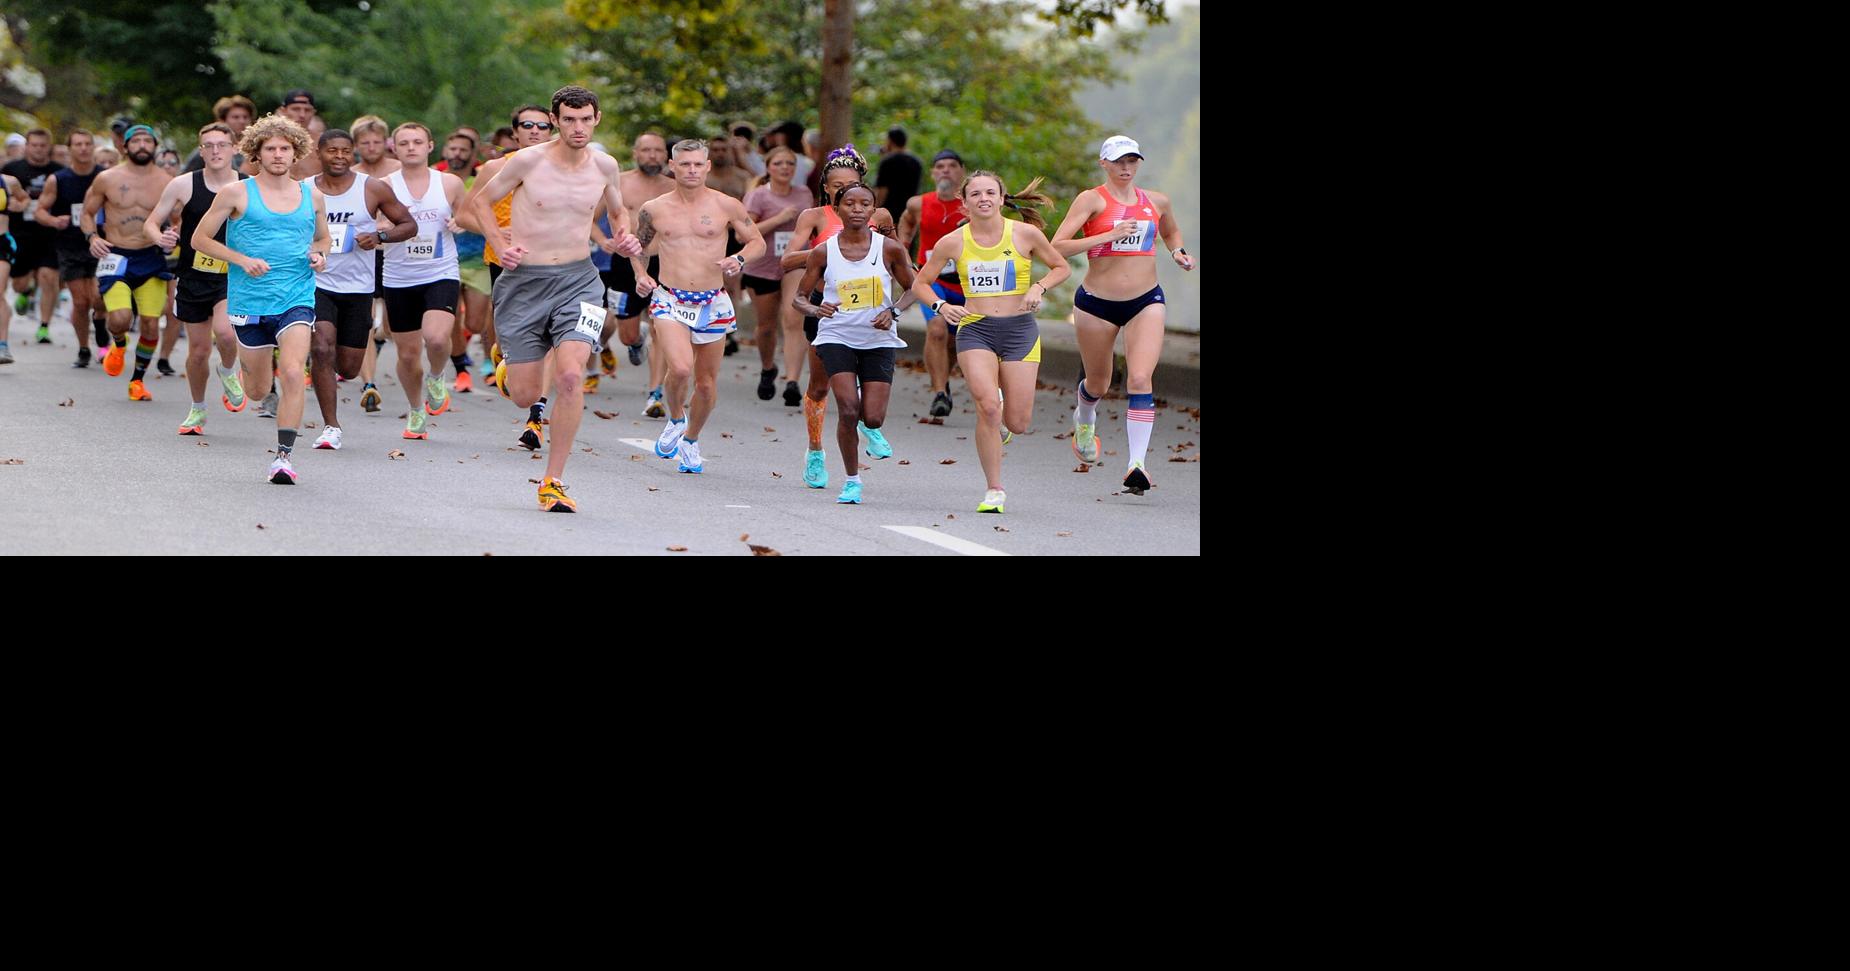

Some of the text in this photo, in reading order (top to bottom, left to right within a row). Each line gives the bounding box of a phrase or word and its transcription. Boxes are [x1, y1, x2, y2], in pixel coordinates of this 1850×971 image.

[407, 245, 433, 254] 1459
[201, 257, 214, 267] 73
[970, 276, 1000, 287] 1251
[850, 293, 860, 304] 2
